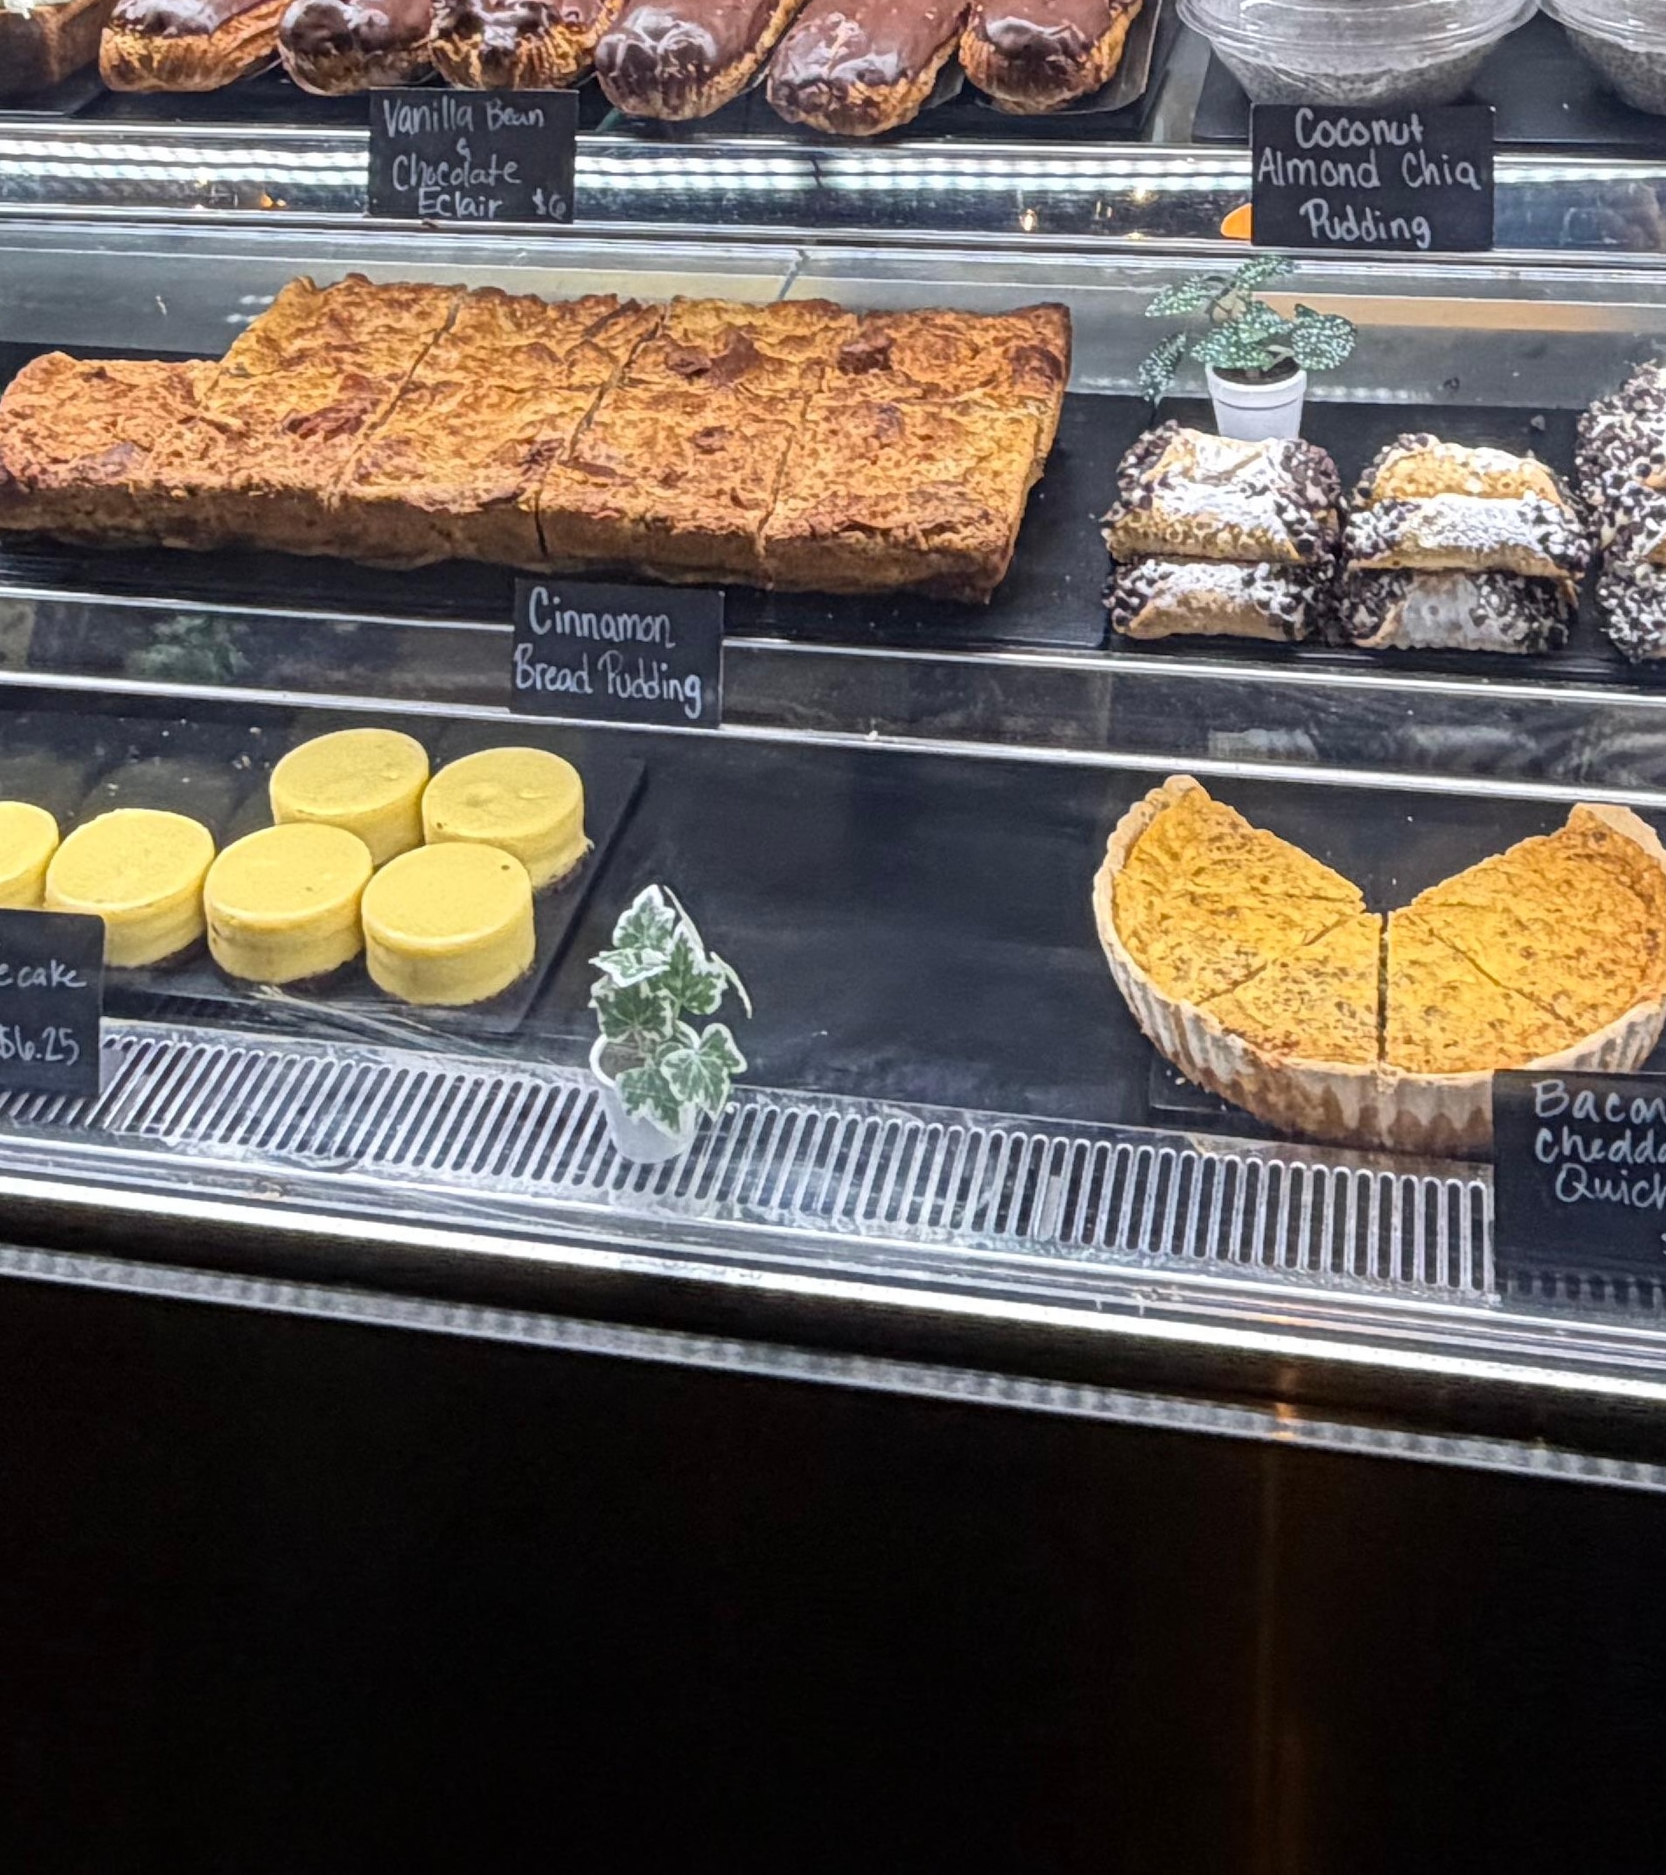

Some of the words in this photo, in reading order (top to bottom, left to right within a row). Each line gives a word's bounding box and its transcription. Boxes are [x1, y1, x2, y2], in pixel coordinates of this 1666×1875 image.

[383, 94, 474, 138] Vanilla
[485, 97, 545, 132] Bean
[1294, 106, 1426, 150] Coconut
[392, 151, 523, 192] Chocolate
[1256, 146, 1382, 189] Almond
[1400, 148, 1483, 192] Chia
[418, 186, 505, 219] Eclair
[532, 187, 568, 221] $6
[1298, 197, 1433, 250] Pudding
[529, 585, 677, 650] Cinnamon
[513, 641, 595, 696] Bread
[597, 648, 703, 720] Pudding
